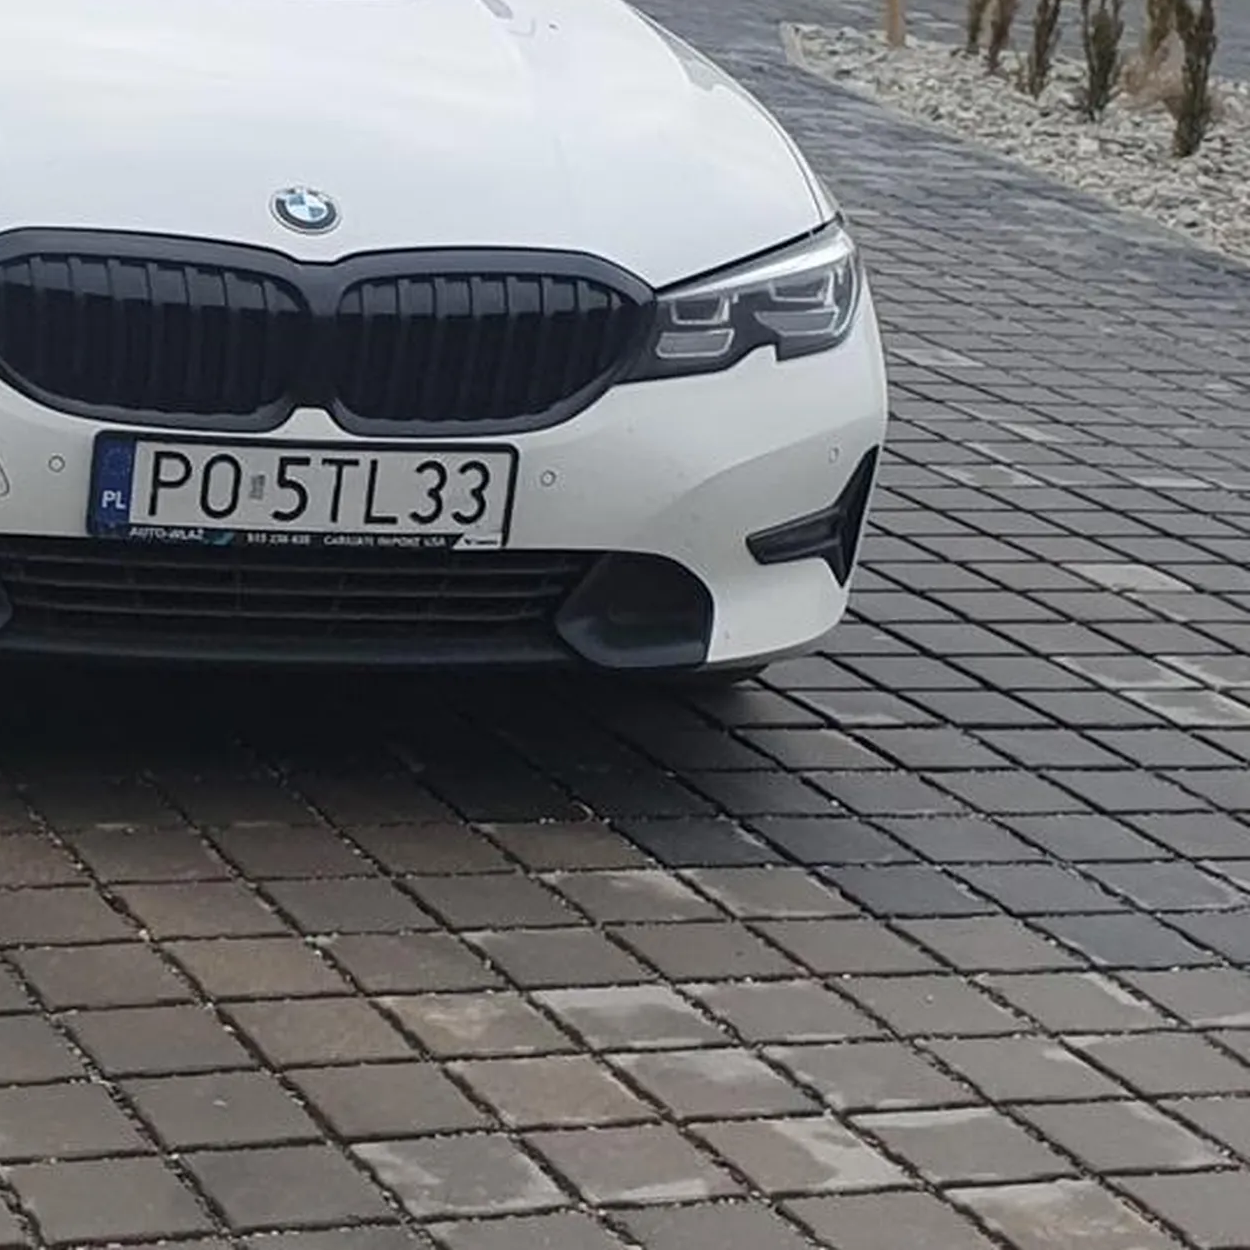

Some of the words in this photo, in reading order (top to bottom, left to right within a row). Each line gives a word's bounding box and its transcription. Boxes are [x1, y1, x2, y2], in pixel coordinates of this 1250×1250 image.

[101, 490, 127, 509] PL
[148, 451, 242, 519] PO
[272, 456, 490, 524] 5TL33
